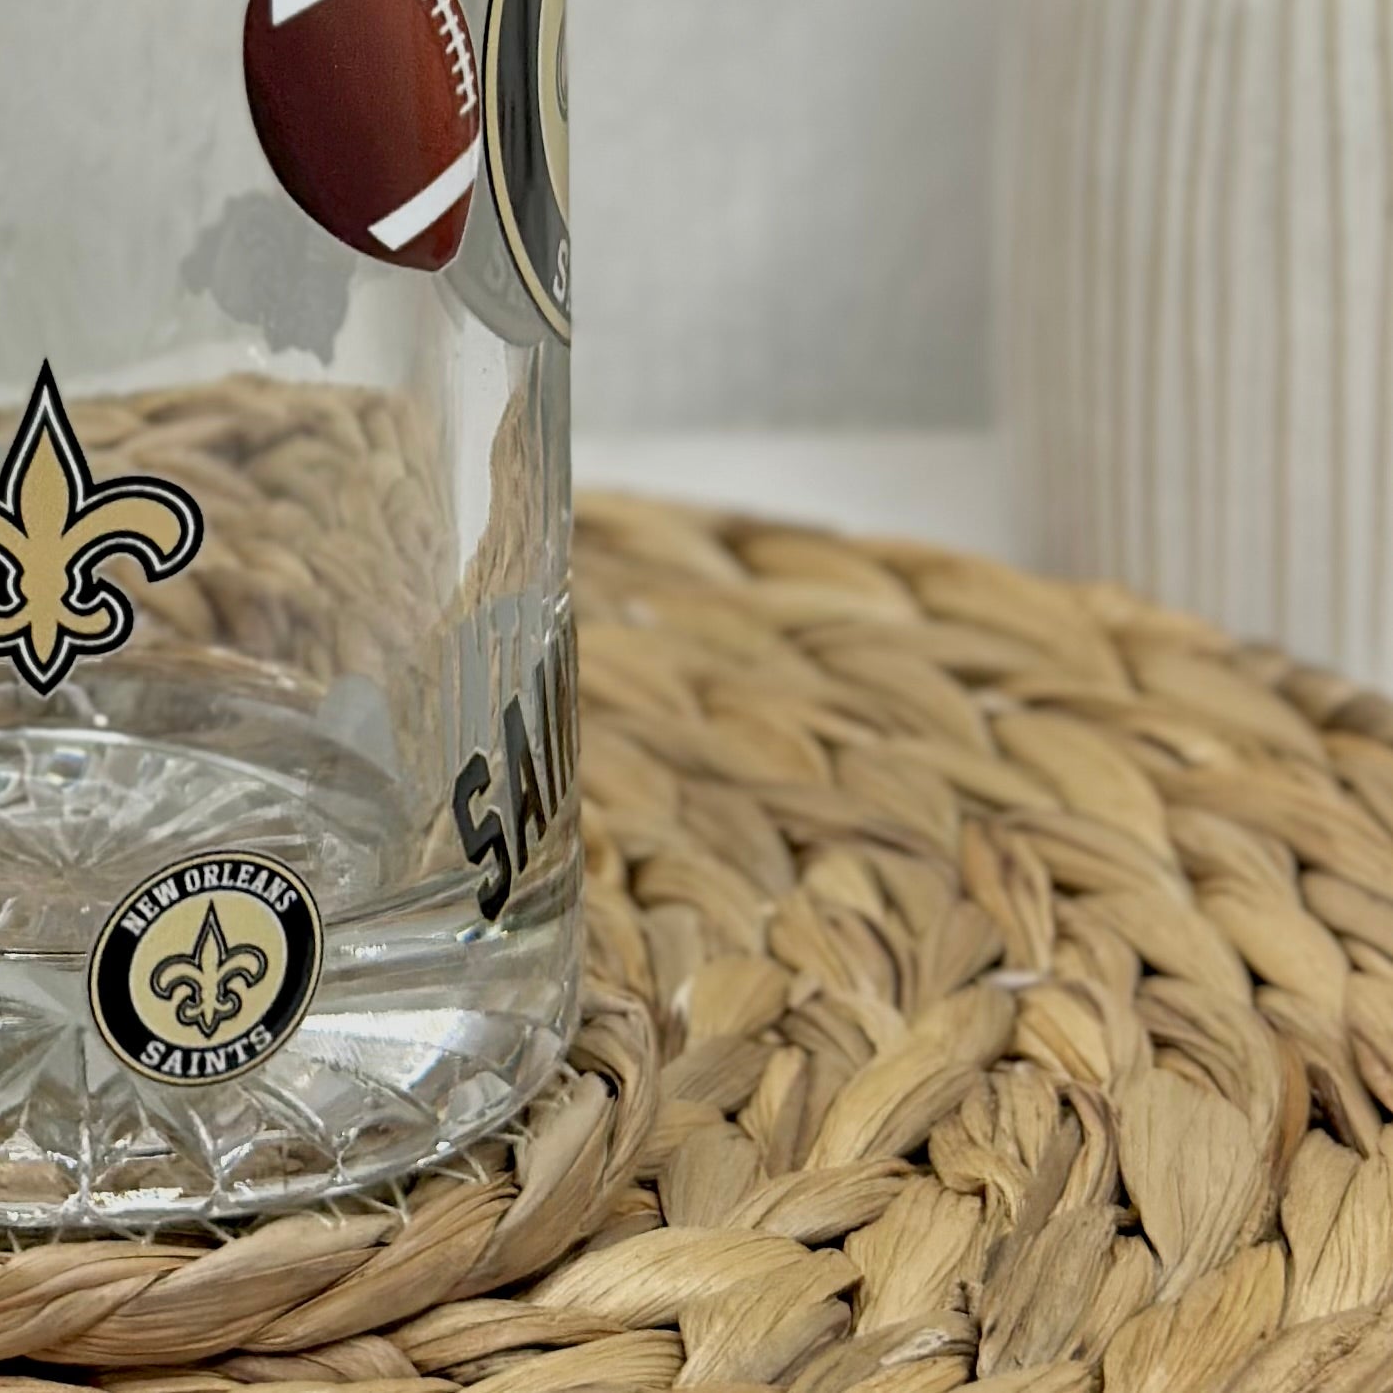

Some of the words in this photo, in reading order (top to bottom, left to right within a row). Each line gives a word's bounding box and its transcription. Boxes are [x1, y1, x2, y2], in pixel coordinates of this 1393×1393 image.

[121, 879, 179, 936] NEW
[184, 863, 298, 912] ORLEANS
[140, 1024, 273, 1075] SAINTS
